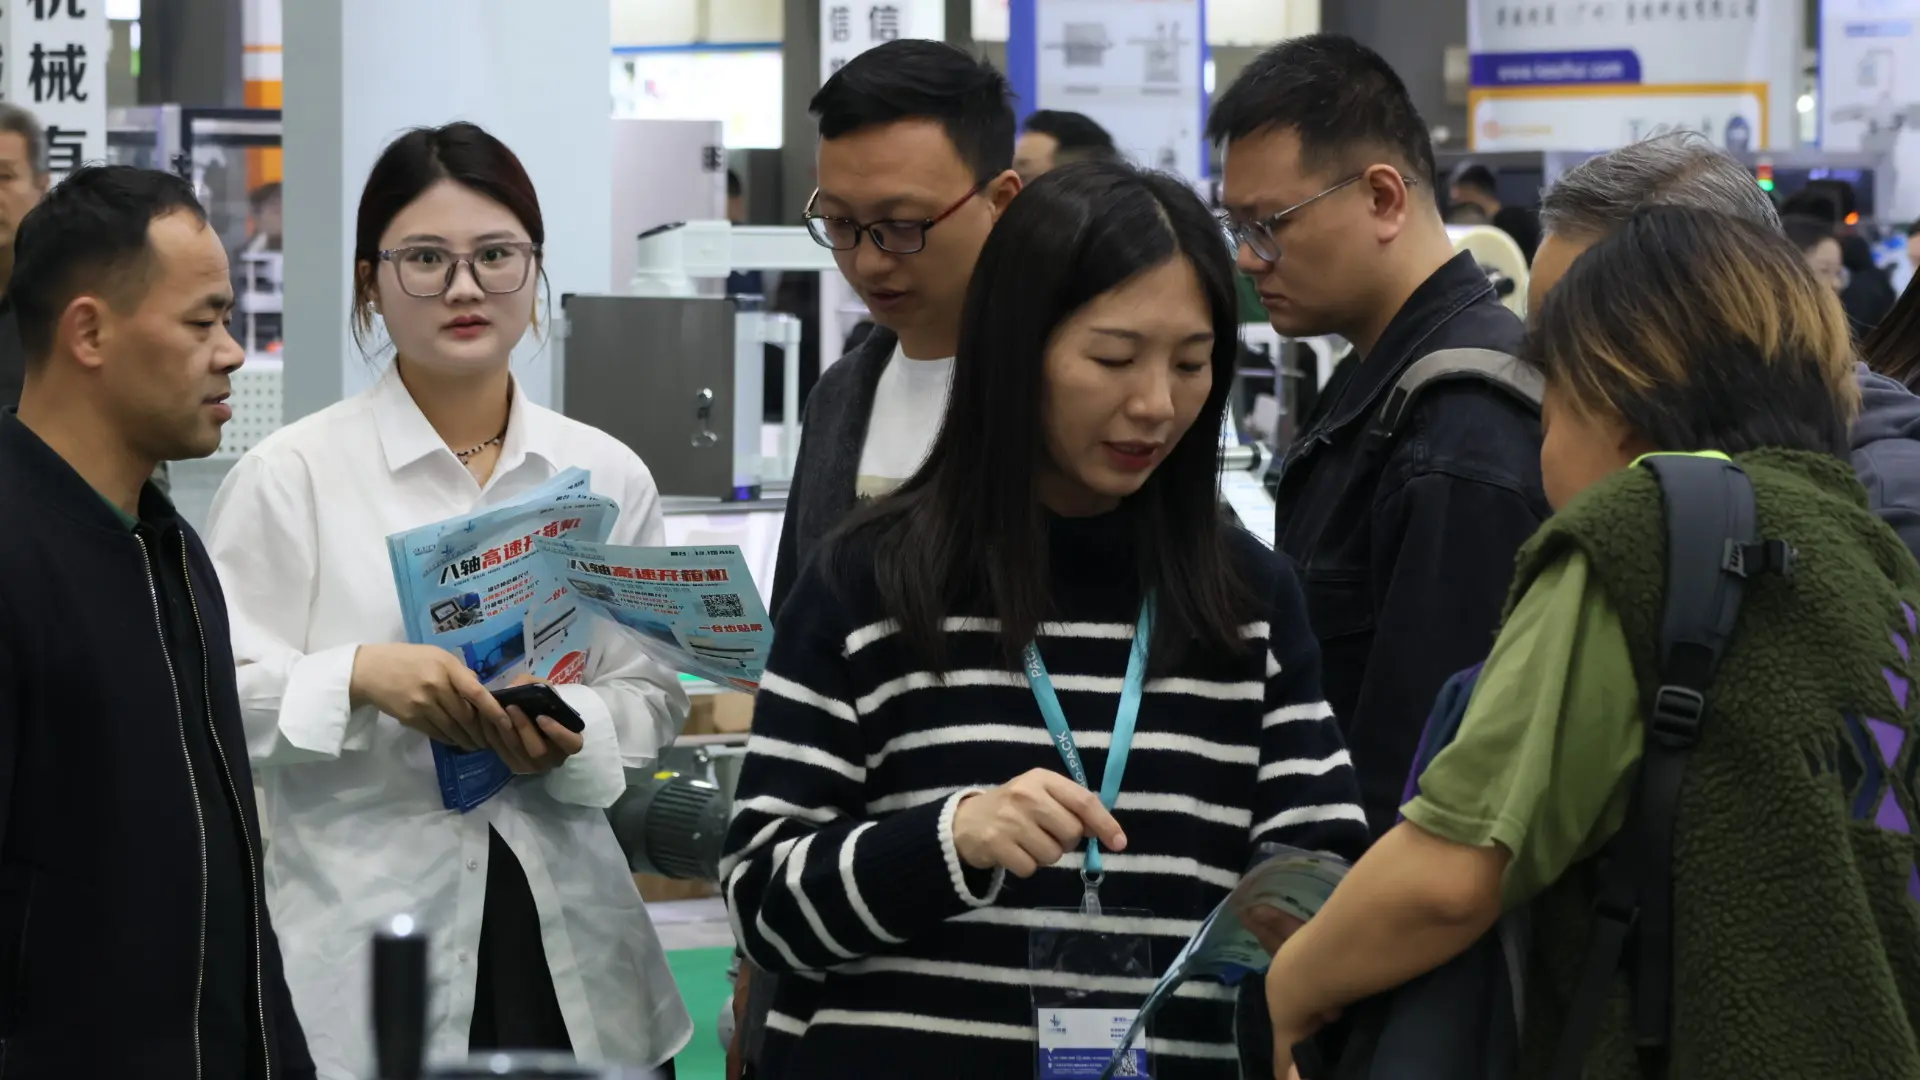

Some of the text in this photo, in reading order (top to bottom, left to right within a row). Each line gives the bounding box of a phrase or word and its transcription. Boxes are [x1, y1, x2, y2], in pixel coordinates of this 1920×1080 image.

[869, 6, 899, 42] 信
[571, 559, 729, 582] 八轴高速开箱机
[1026, 647, 1043, 678] PAC
